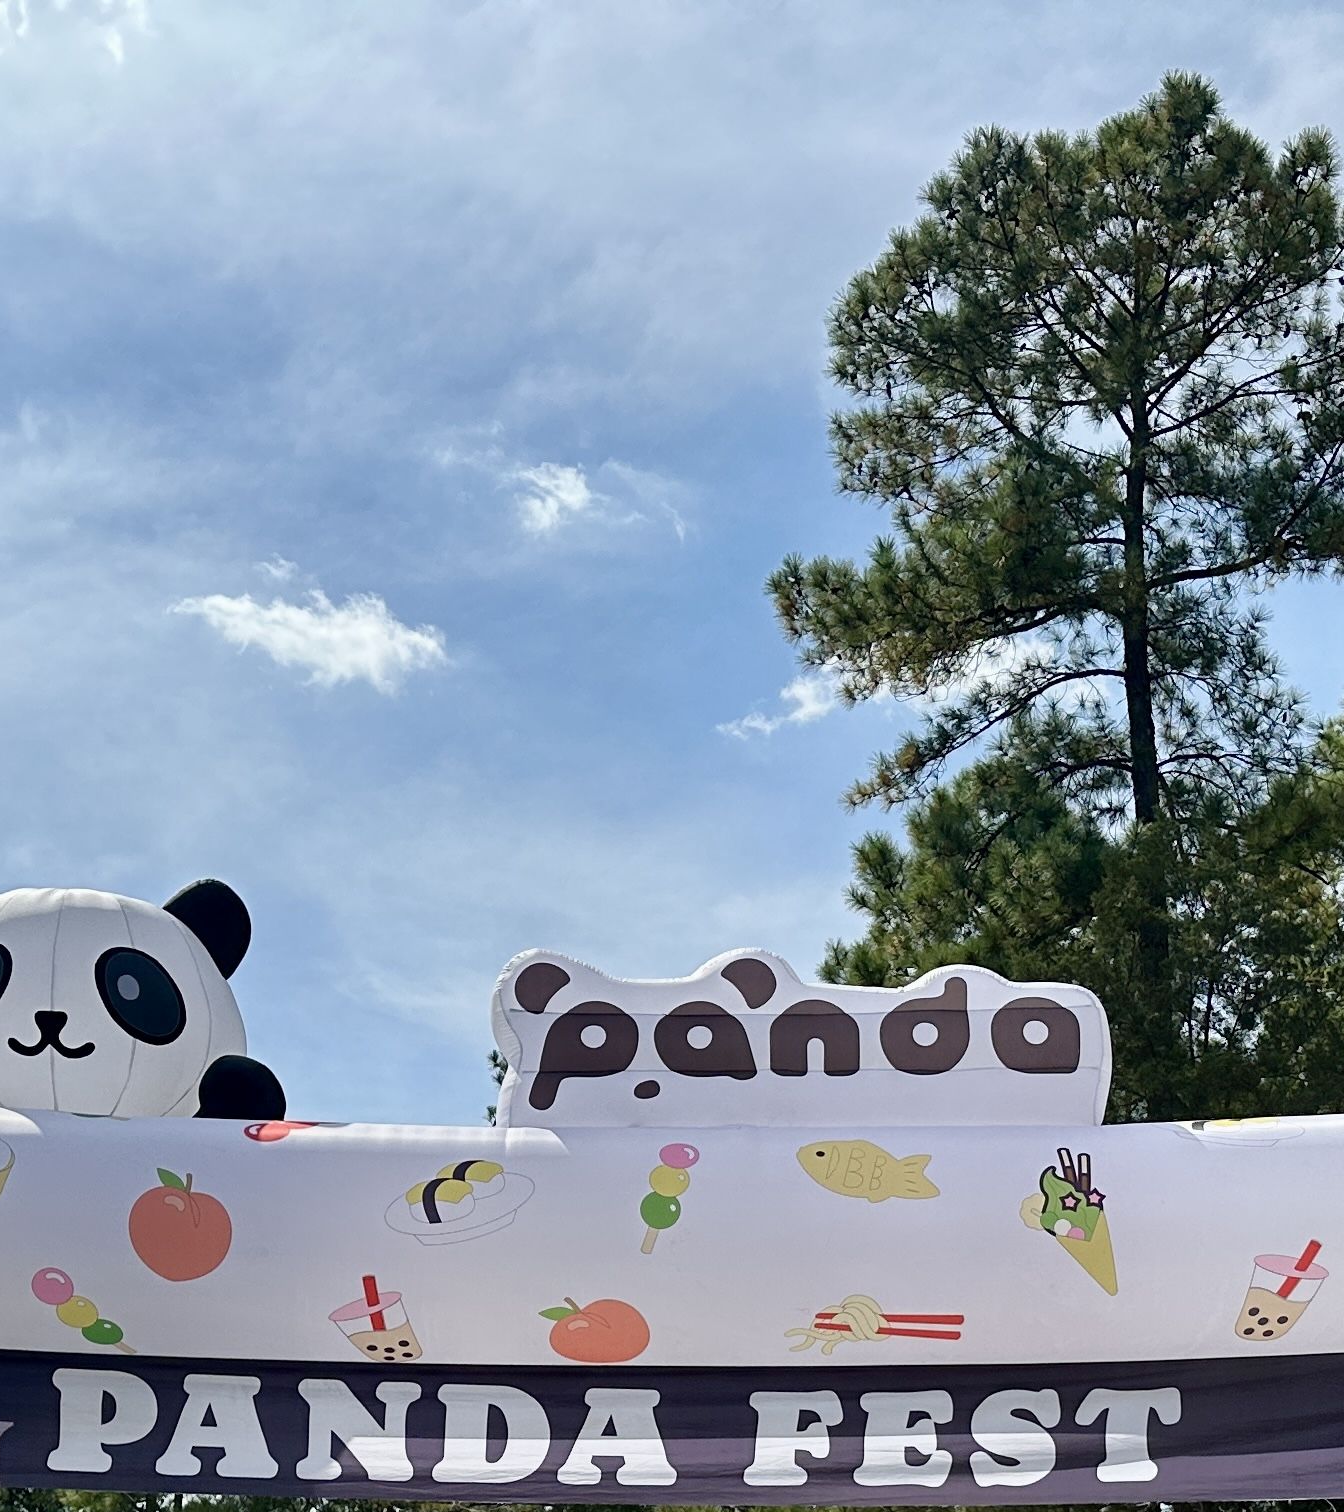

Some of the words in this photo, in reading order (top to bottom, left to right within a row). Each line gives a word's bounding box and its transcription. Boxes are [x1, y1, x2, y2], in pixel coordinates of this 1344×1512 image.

[528, 976, 1081, 1111] panda
[46, 1367, 678, 1487] PANDA
[743, 1386, 1182, 1488] FEST
